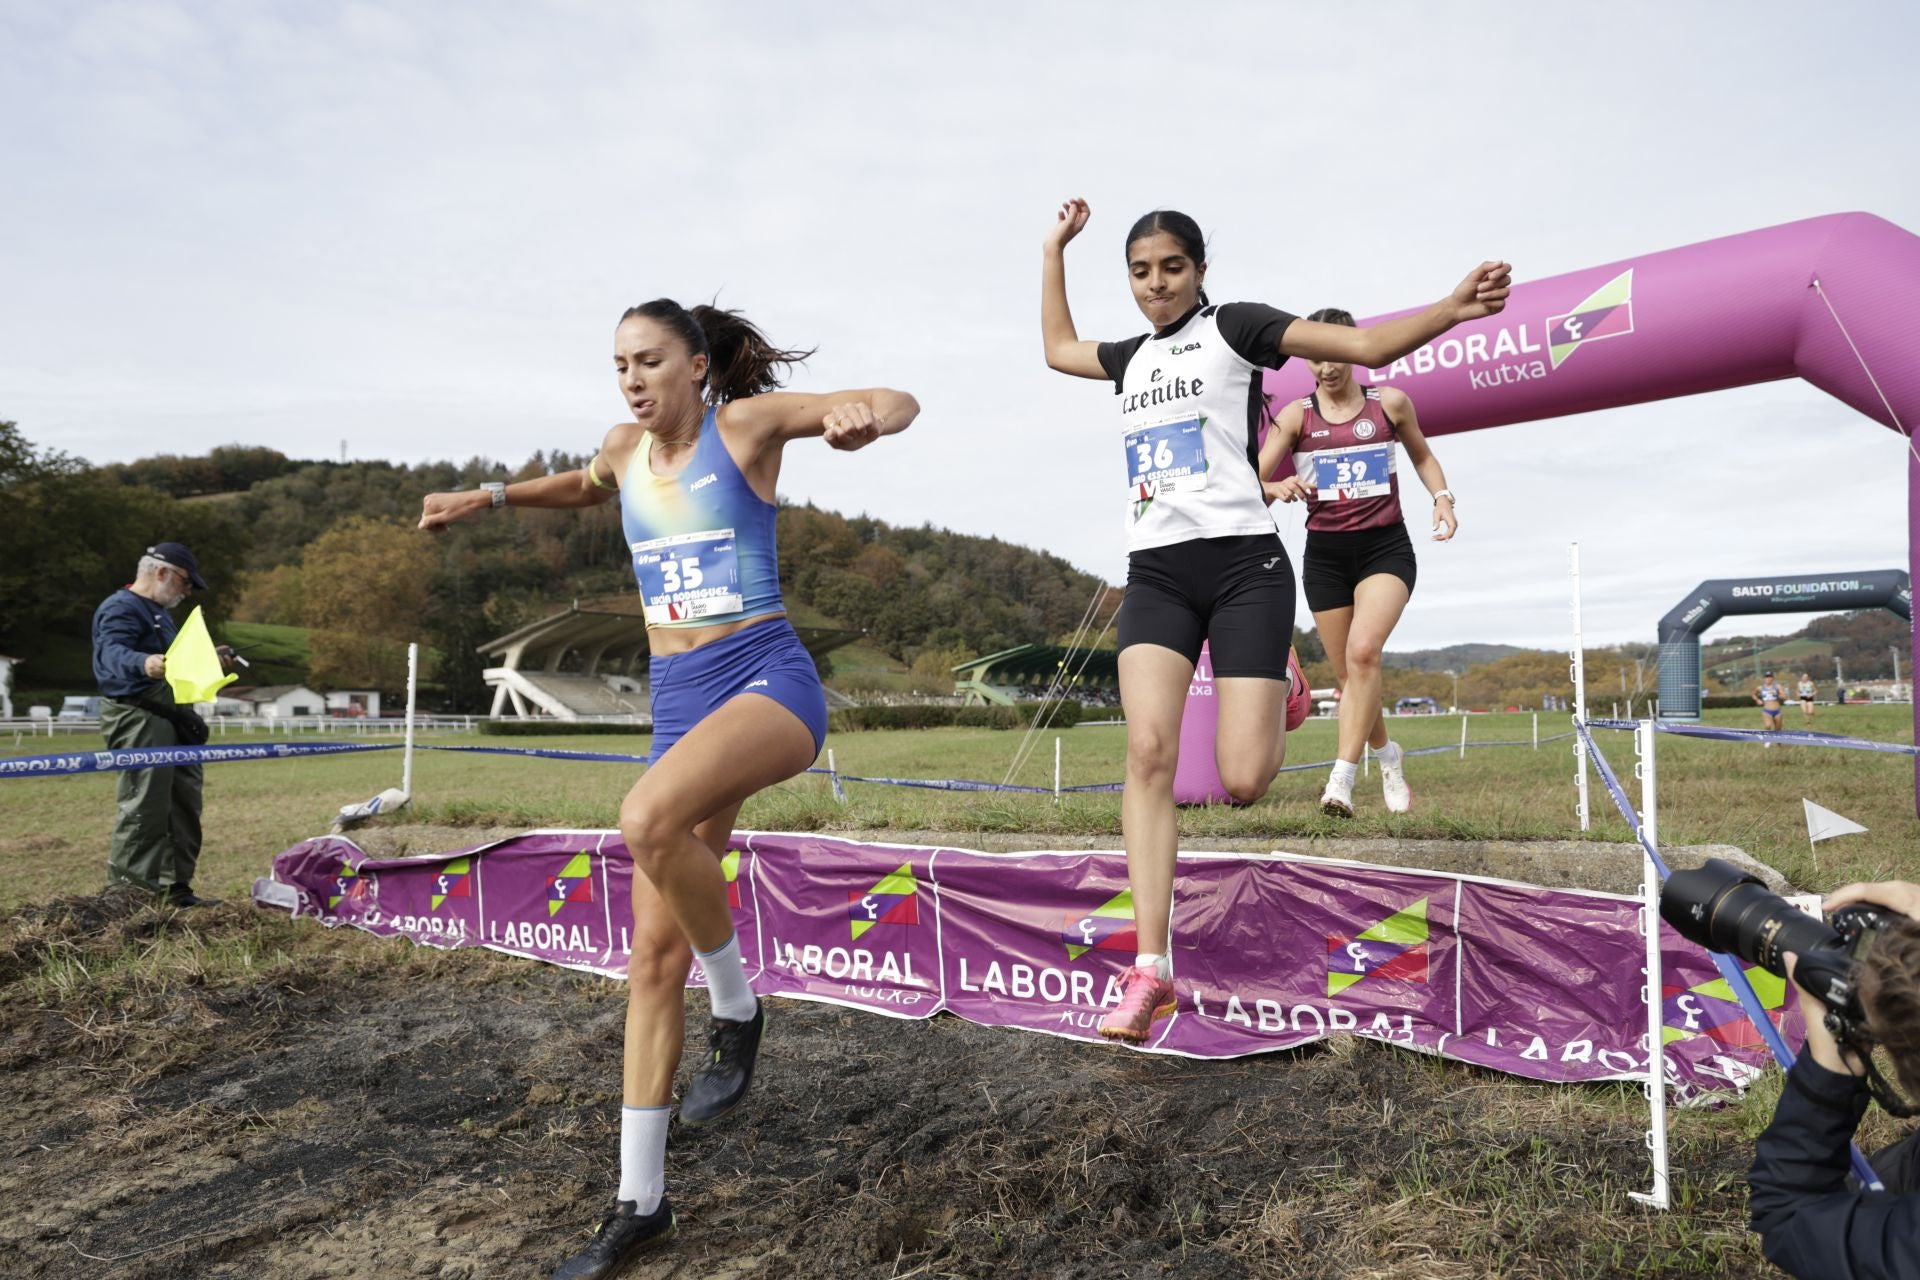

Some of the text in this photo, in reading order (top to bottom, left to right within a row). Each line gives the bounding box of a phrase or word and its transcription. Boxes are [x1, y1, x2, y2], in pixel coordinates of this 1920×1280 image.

[1468, 360, 1546, 390] kutxa
[1311, 429, 1330, 438] KCS
[1136, 438, 1173, 474] 36
[1336, 460, 1367, 483] 39
[690, 473, 717, 493] HOKA
[660, 556, 703, 593] 35
[1732, 586, 1773, 597] SALTO
[1775, 580, 1859, 595] FOUNDATION
[491, 920, 598, 953] LABORAL
[773, 937, 931, 988] LABORAL
[959, 958, 1125, 1009] LABORA
